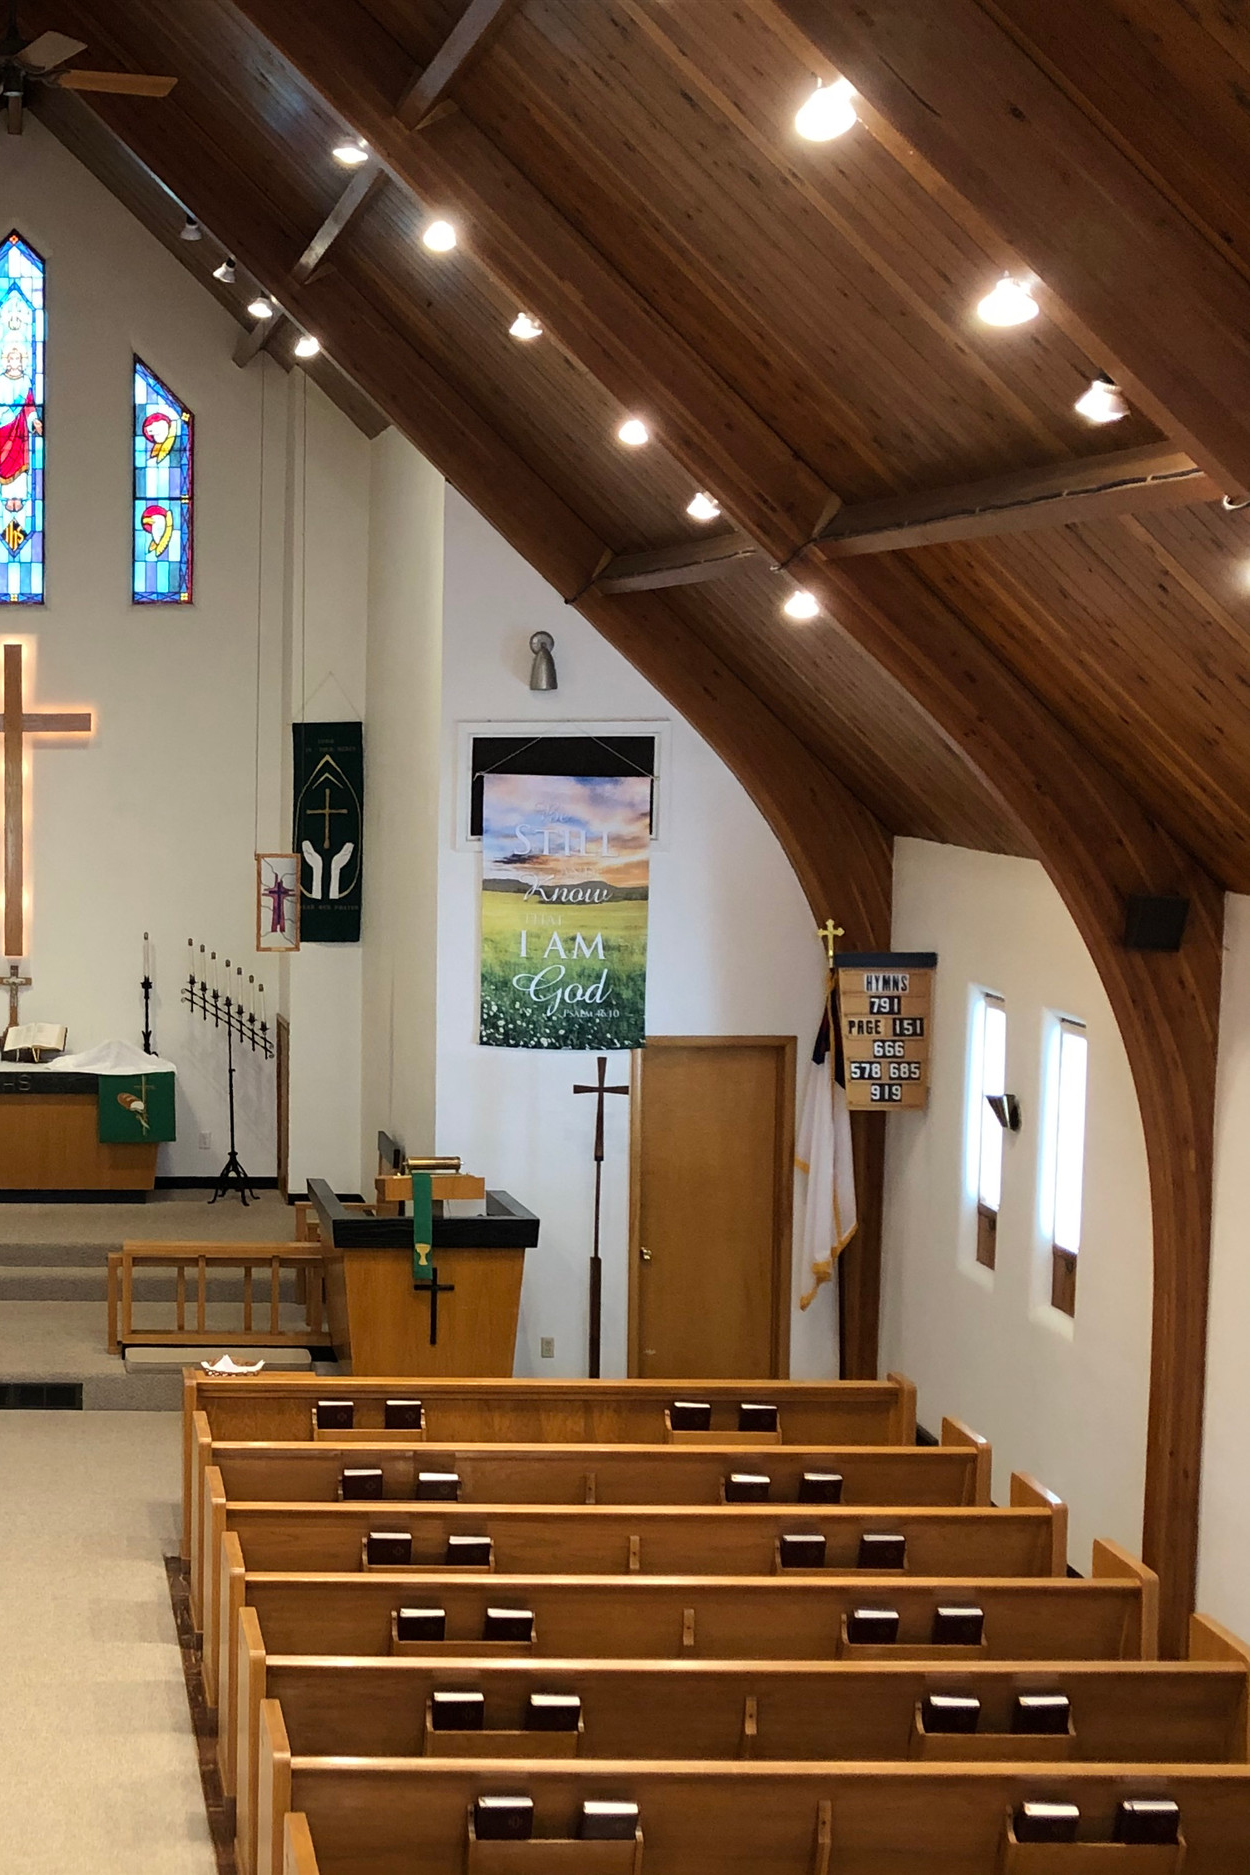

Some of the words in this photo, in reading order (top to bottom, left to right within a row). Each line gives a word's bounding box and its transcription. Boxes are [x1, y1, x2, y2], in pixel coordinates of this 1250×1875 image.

[514, 824, 619, 857] STILL
[519, 873, 613, 904] Know
[520, 930, 527, 958] I
[543, 931, 607, 960] AM
[866, 974, 908, 991] HYMNS
[512, 964, 615, 1018] God
[870, 998, 899, 1013] 791
[848, 1019, 882, 1034] PAGE
[895, 1019, 922, 1034] 151
[873, 1042, 905, 1058] 666
[851, 1063, 882, 1079] 578
[889, 1063, 921, 1079] 685
[871, 1085, 902, 1101] 919
